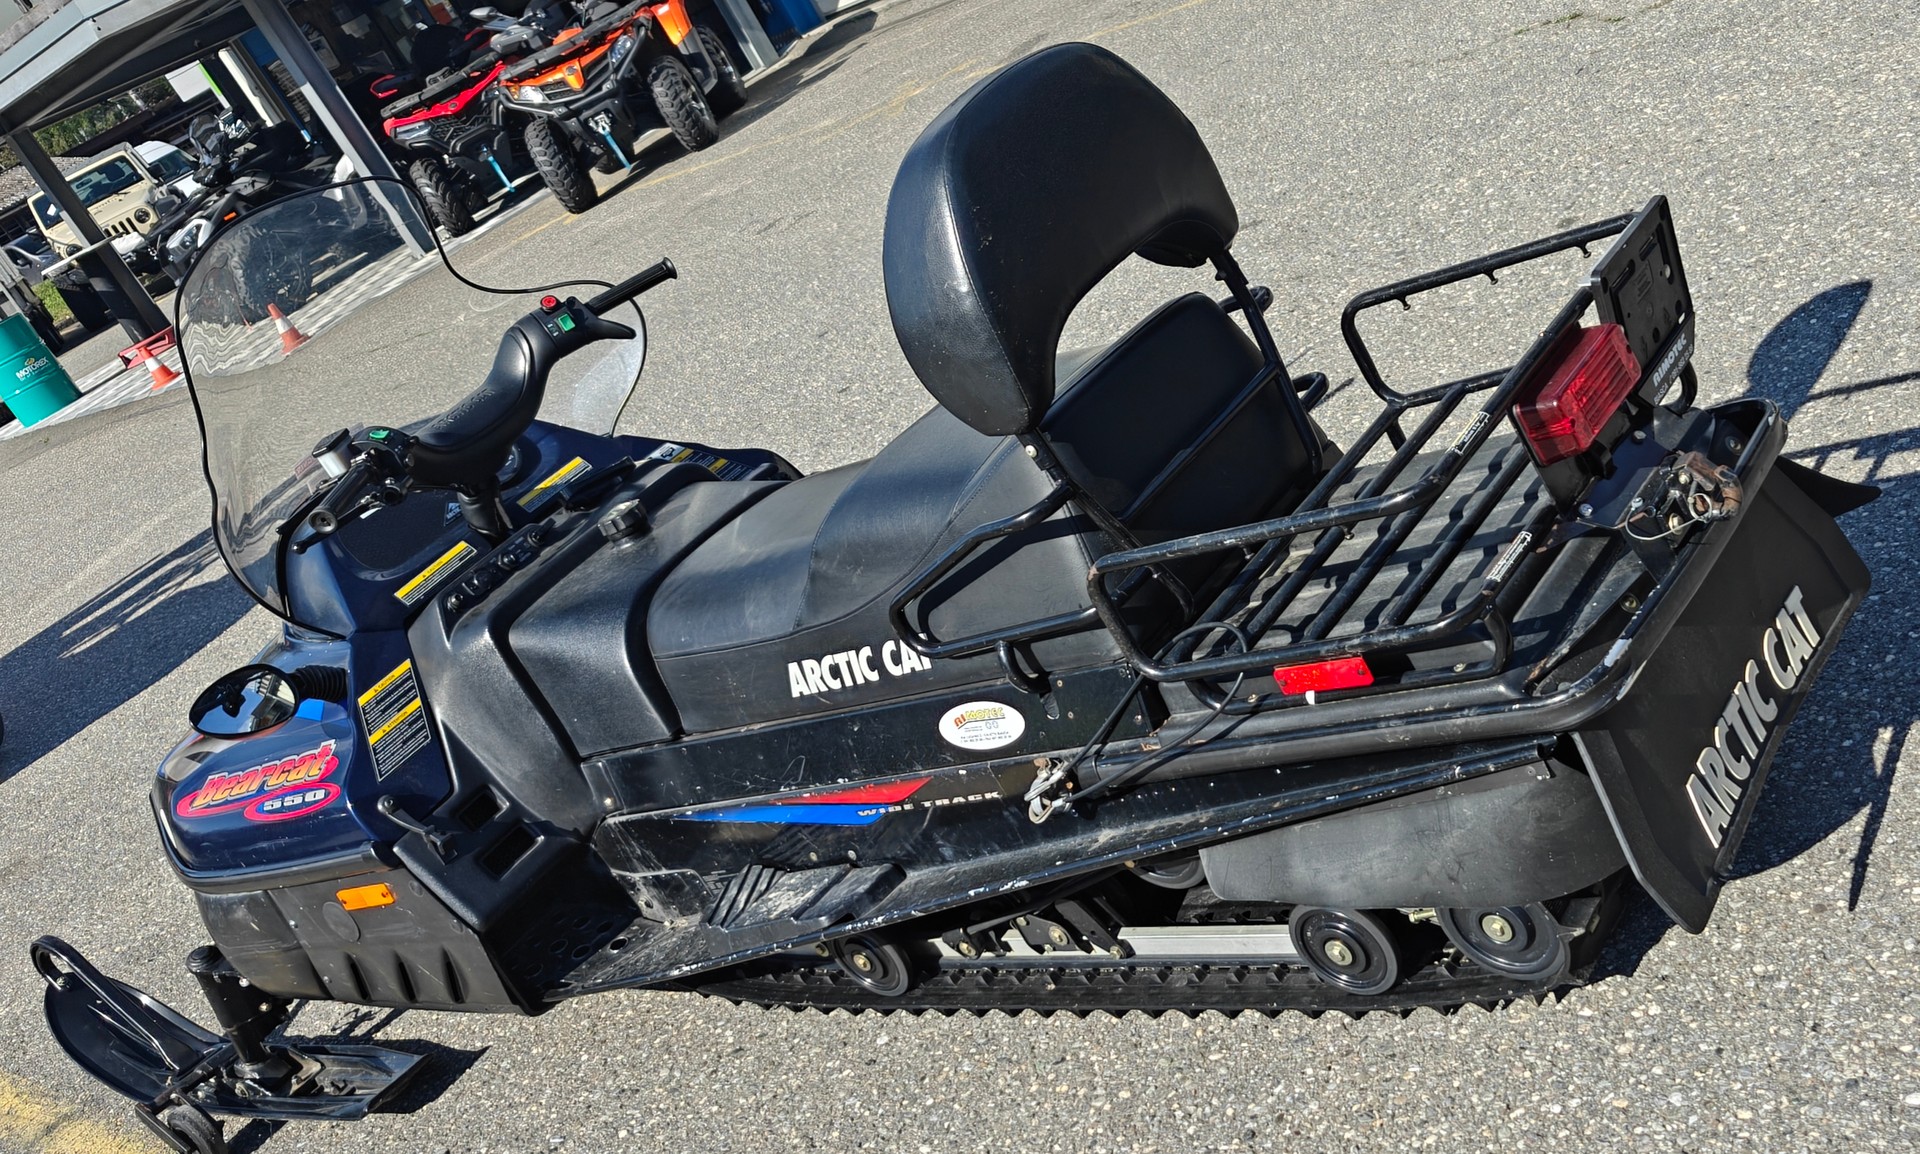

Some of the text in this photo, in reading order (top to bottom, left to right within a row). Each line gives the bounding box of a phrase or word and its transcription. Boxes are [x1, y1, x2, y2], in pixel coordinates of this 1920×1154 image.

[16, 356, 49, 382] MOTOREX
[788, 646, 880, 698] ARCTIC
[1685, 585, 1821, 850] ARCTIC CAT
[190, 739, 338, 812] Bearcat
[263, 789, 326, 812] 550
[857, 791, 1003, 817] WIDE TRACK
